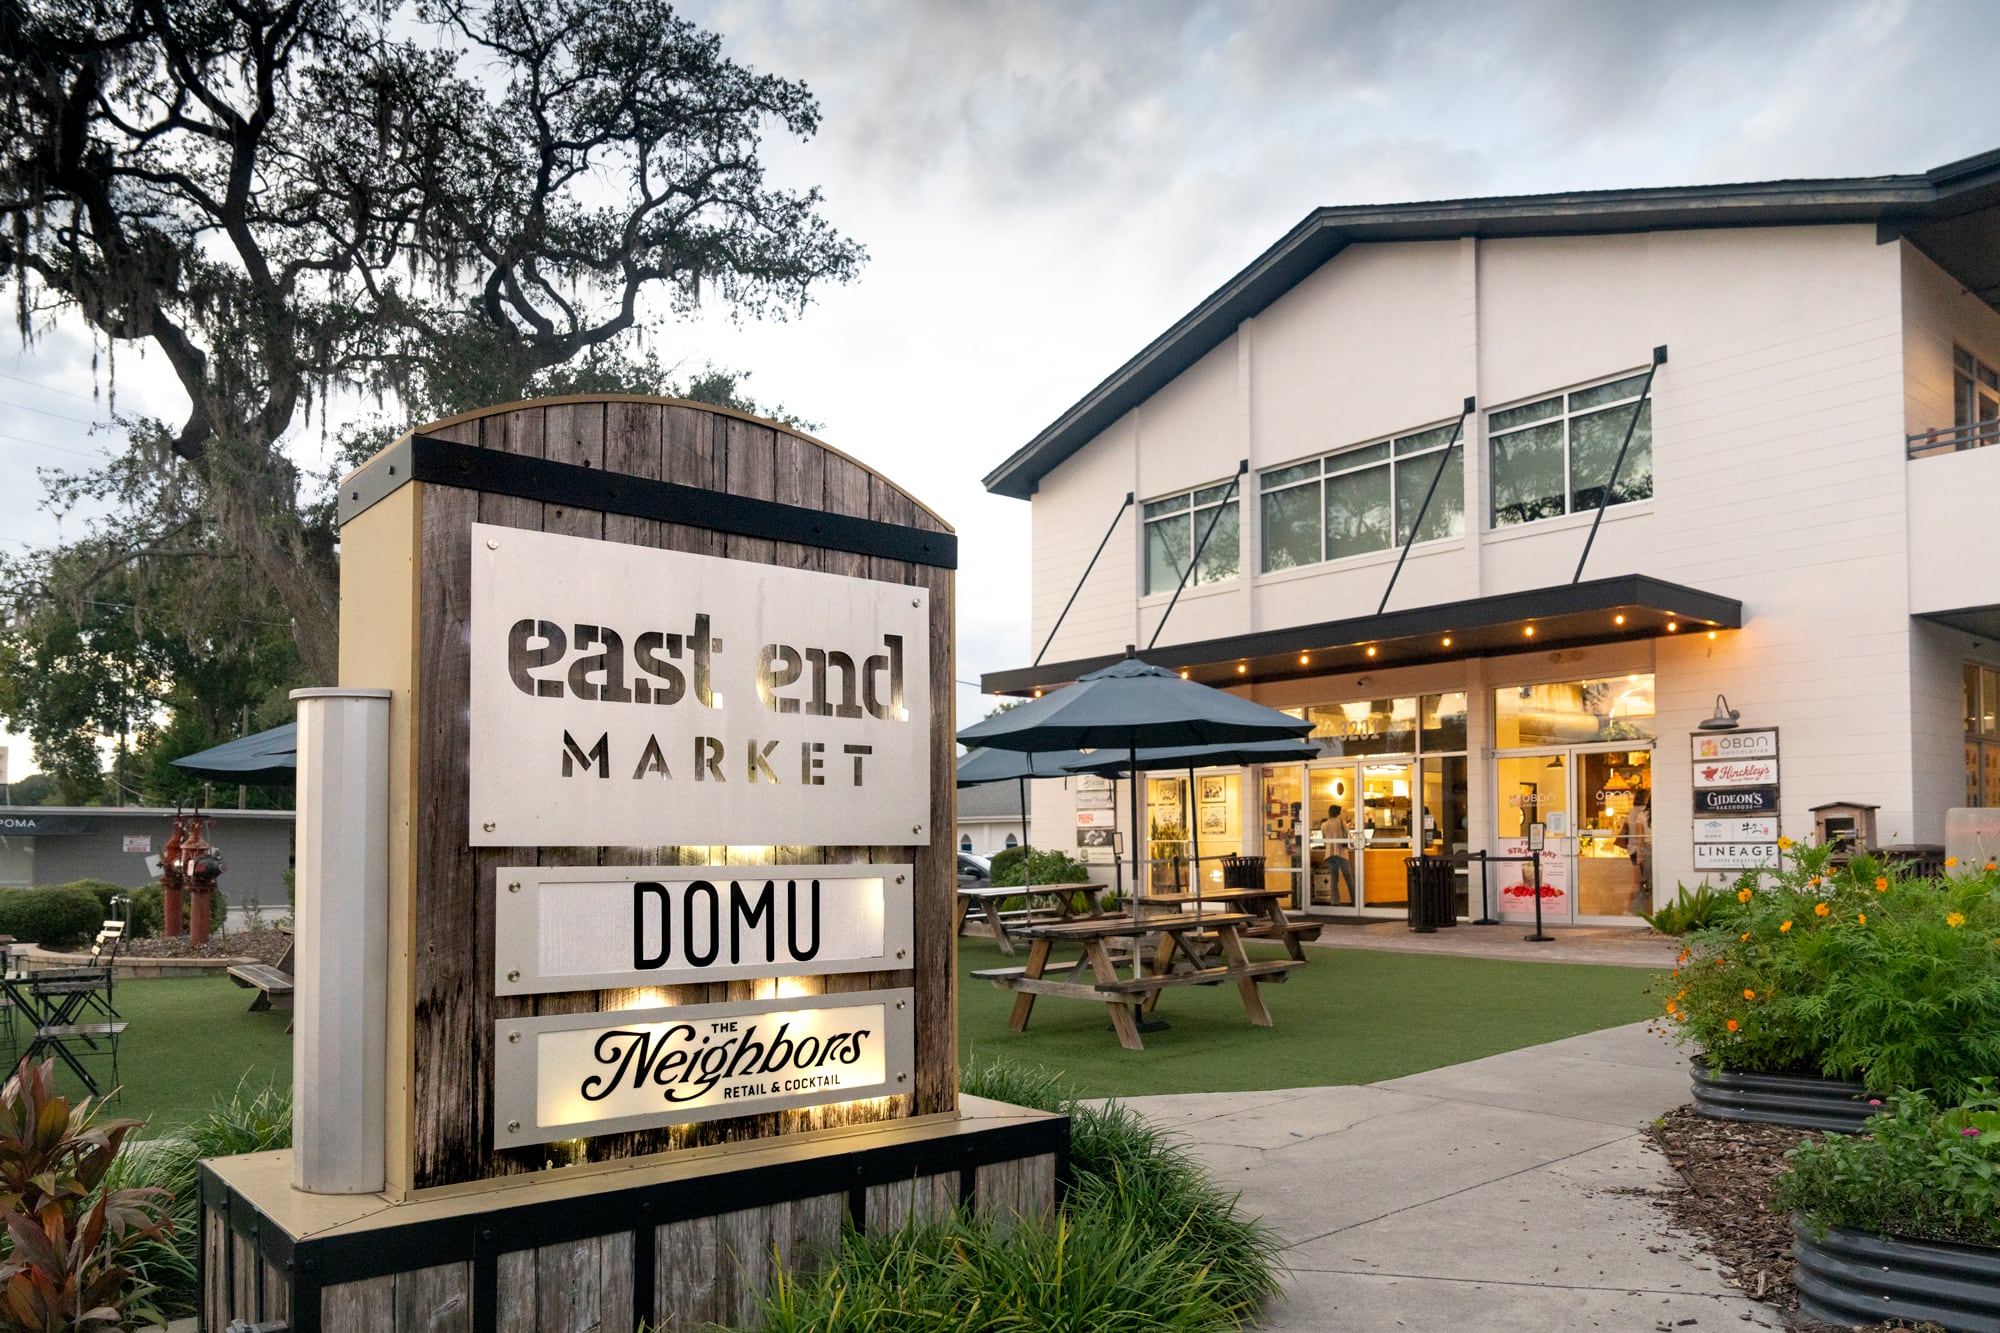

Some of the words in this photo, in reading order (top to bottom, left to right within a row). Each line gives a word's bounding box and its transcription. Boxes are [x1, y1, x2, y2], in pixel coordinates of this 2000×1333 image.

[508, 613, 723, 709] east
[756, 634, 909, 722] end
[1339, 718, 1380, 741] 3201
[561, 729, 872, 786] MARKET
[1719, 764, 1770, 780] Hinckley's
[1707, 791, 1763, 806] GIDEON'S
[1507, 847, 1558, 859] STRARRY
[1698, 846, 1773, 857] LINEAGE
[633, 879, 821, 970] DOMU
[711, 1022, 738, 1034] THE
[581, 1024, 870, 1102] Neighbors
[724, 1086, 767, 1099] RETAIL
[771, 1082, 780, 1093] &
[785, 1075, 840, 1091] COCKTAIL
